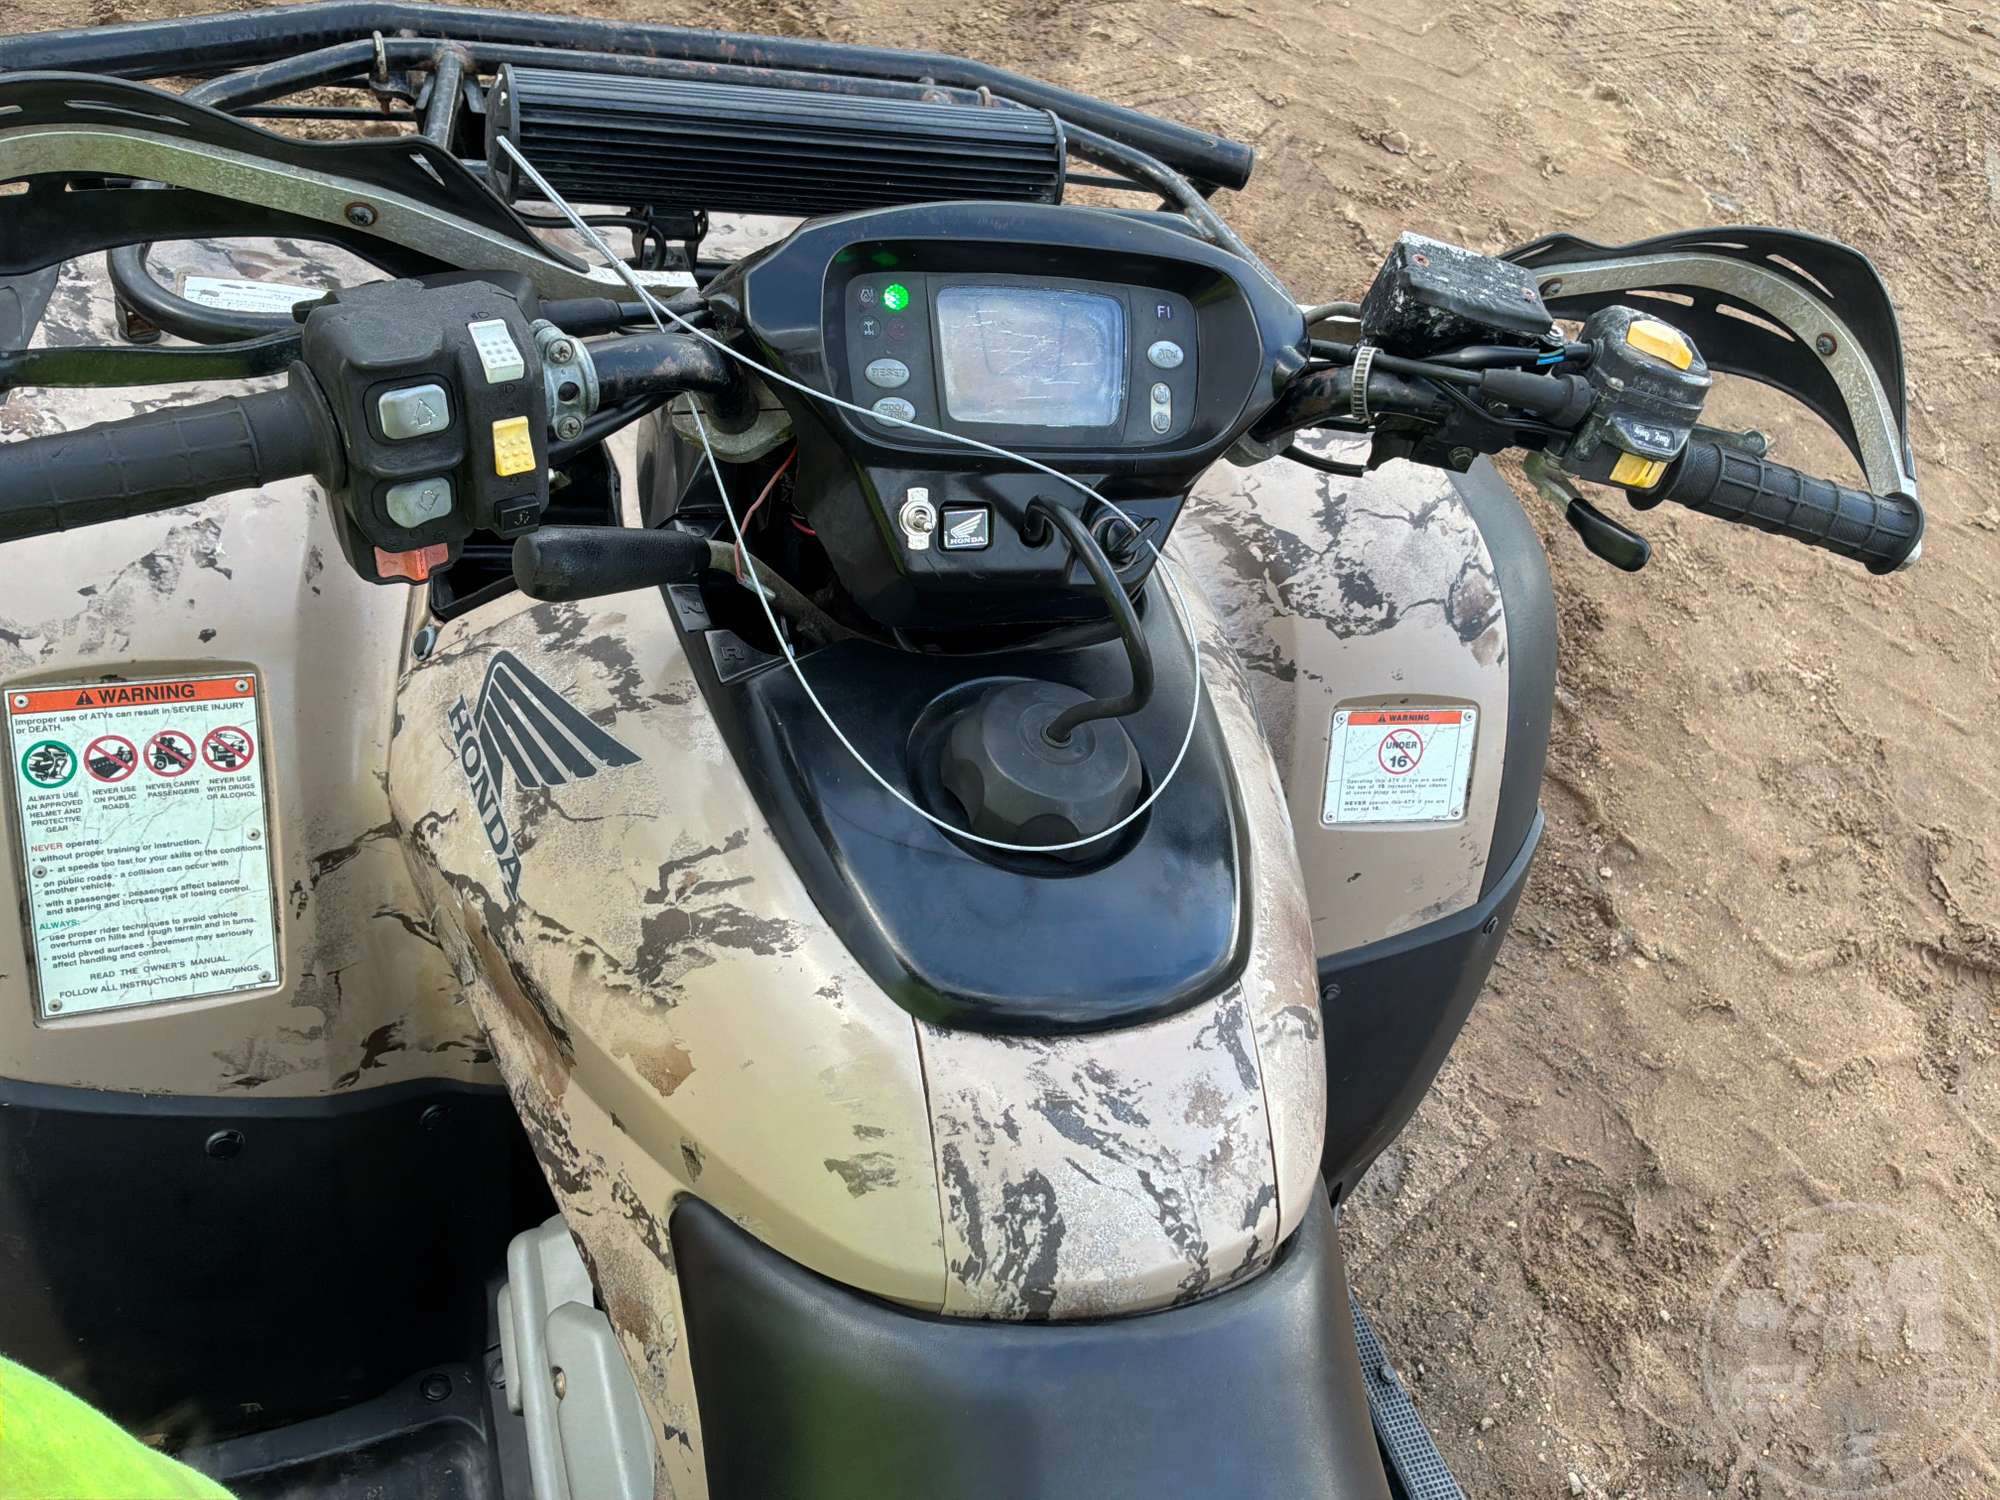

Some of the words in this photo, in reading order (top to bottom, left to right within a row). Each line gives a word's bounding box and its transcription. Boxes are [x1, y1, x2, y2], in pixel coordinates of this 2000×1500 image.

[1157, 305, 1171, 319] FI
[950, 536, 985, 544] HONDA
[98, 684, 195, 704] WARNING
[15, 718, 57, 726] Improper
[59, 715, 76, 723] use
[90, 712, 113, 720] ATVs
[115, 710, 132, 718] can
[134, 708, 159, 717] result
[173, 704, 209, 713] SEVERE
[211, 702, 244, 710] INJURY
[28, 724, 64, 732] DEATH.
[1386, 741, 1417, 749] UNDER
[1390, 756, 1407, 768] 16
[173, 780, 200, 788] CARRY
[209, 777, 234, 785] NEVER
[228, 783, 255, 791] DRUGS
[28, 793, 60, 802] ALWAYS
[63, 791, 79, 799] USE
[106, 794, 136, 802] PUBLIC
[148, 788, 199, 798] PASSENGERS
[220, 791, 256, 799] ALCOHOL
[448, 695, 521, 904] HONDA
[40, 799, 83, 809] APPROVED
[29, 810, 62, 819] HELMET
[31, 816, 81, 826] PROTECTIVE
[46, 825, 68, 833] GEAR
[31, 843, 63, 853] NEVER
[65, 839, 102, 849] operate:
[40, 853, 72, 863] without
[75, 850, 104, 860] proper
[107, 845, 140, 855] training
[154, 838, 202, 849] instruction.
[68, 862, 99, 873] speeds
[117, 857, 133, 865] fast
[149, 854, 167, 863] your
[170, 851, 191, 859] skills
[220, 844, 264, 854] conditions.
[57, 876, 84, 887] public
[87, 873, 112, 882] roads
[128, 867, 164, 877] collision
[44, 886, 78, 896] another
[81, 882, 115, 891] vehicle.
[74, 893, 120, 905] passenger
[129, 885, 178, 897] passengers
[181, 881, 204, 890] affect
[207, 878, 240, 887] balance
[46, 907, 63, 916] and
[65, 902, 101, 913] steering
[104, 900, 120, 908] and
[122, 895, 159, 906] increase
[162, 892, 177, 901] risk
[191, 888, 217, 898] losing
[219, 885, 251, 894] control.
[39, 919, 80, 930] ALWAYS:
[68, 930, 97, 941] proper
[100, 926, 120, 935] rider
[122, 919, 169, 931] techniques
[183, 914, 205, 923] avoid
[208, 911, 238, 920] vehicle
[50, 938, 92, 950] overturns
[94, 936, 106, 944] on
[108, 932, 126, 941] hills
[129, 930, 145, 938] and
[147, 926, 172, 938] rough
[174, 923, 202, 932] terrain
[233, 917, 256, 925] turns.
[52, 950, 76, 960] avoid
[78, 948, 105, 959] paved
[107, 943, 144, 954] surfaces
[152, 936, 193, 948] pavement
[196, 934, 213, 943] may
[215, 928, 253, 939] seriously
[53, 960, 77, 969] affect
[80, 954, 117, 966] handling
[120, 951, 135, 960] and
[138, 947, 170, 957] control.
[90, 970, 115, 980] READ
[121, 967, 138, 975] THE
[143, 960, 185, 973] OWNER'S
[191, 955, 231, 966] MANUAL.
[59, 986, 97, 998] FOLLOW
[101, 983, 117, 991] ALL
[120, 973, 188, 990] INSTRUCTIONS
[190, 970, 209, 980] AND
[211, 964, 262, 977] WARNINGS.
